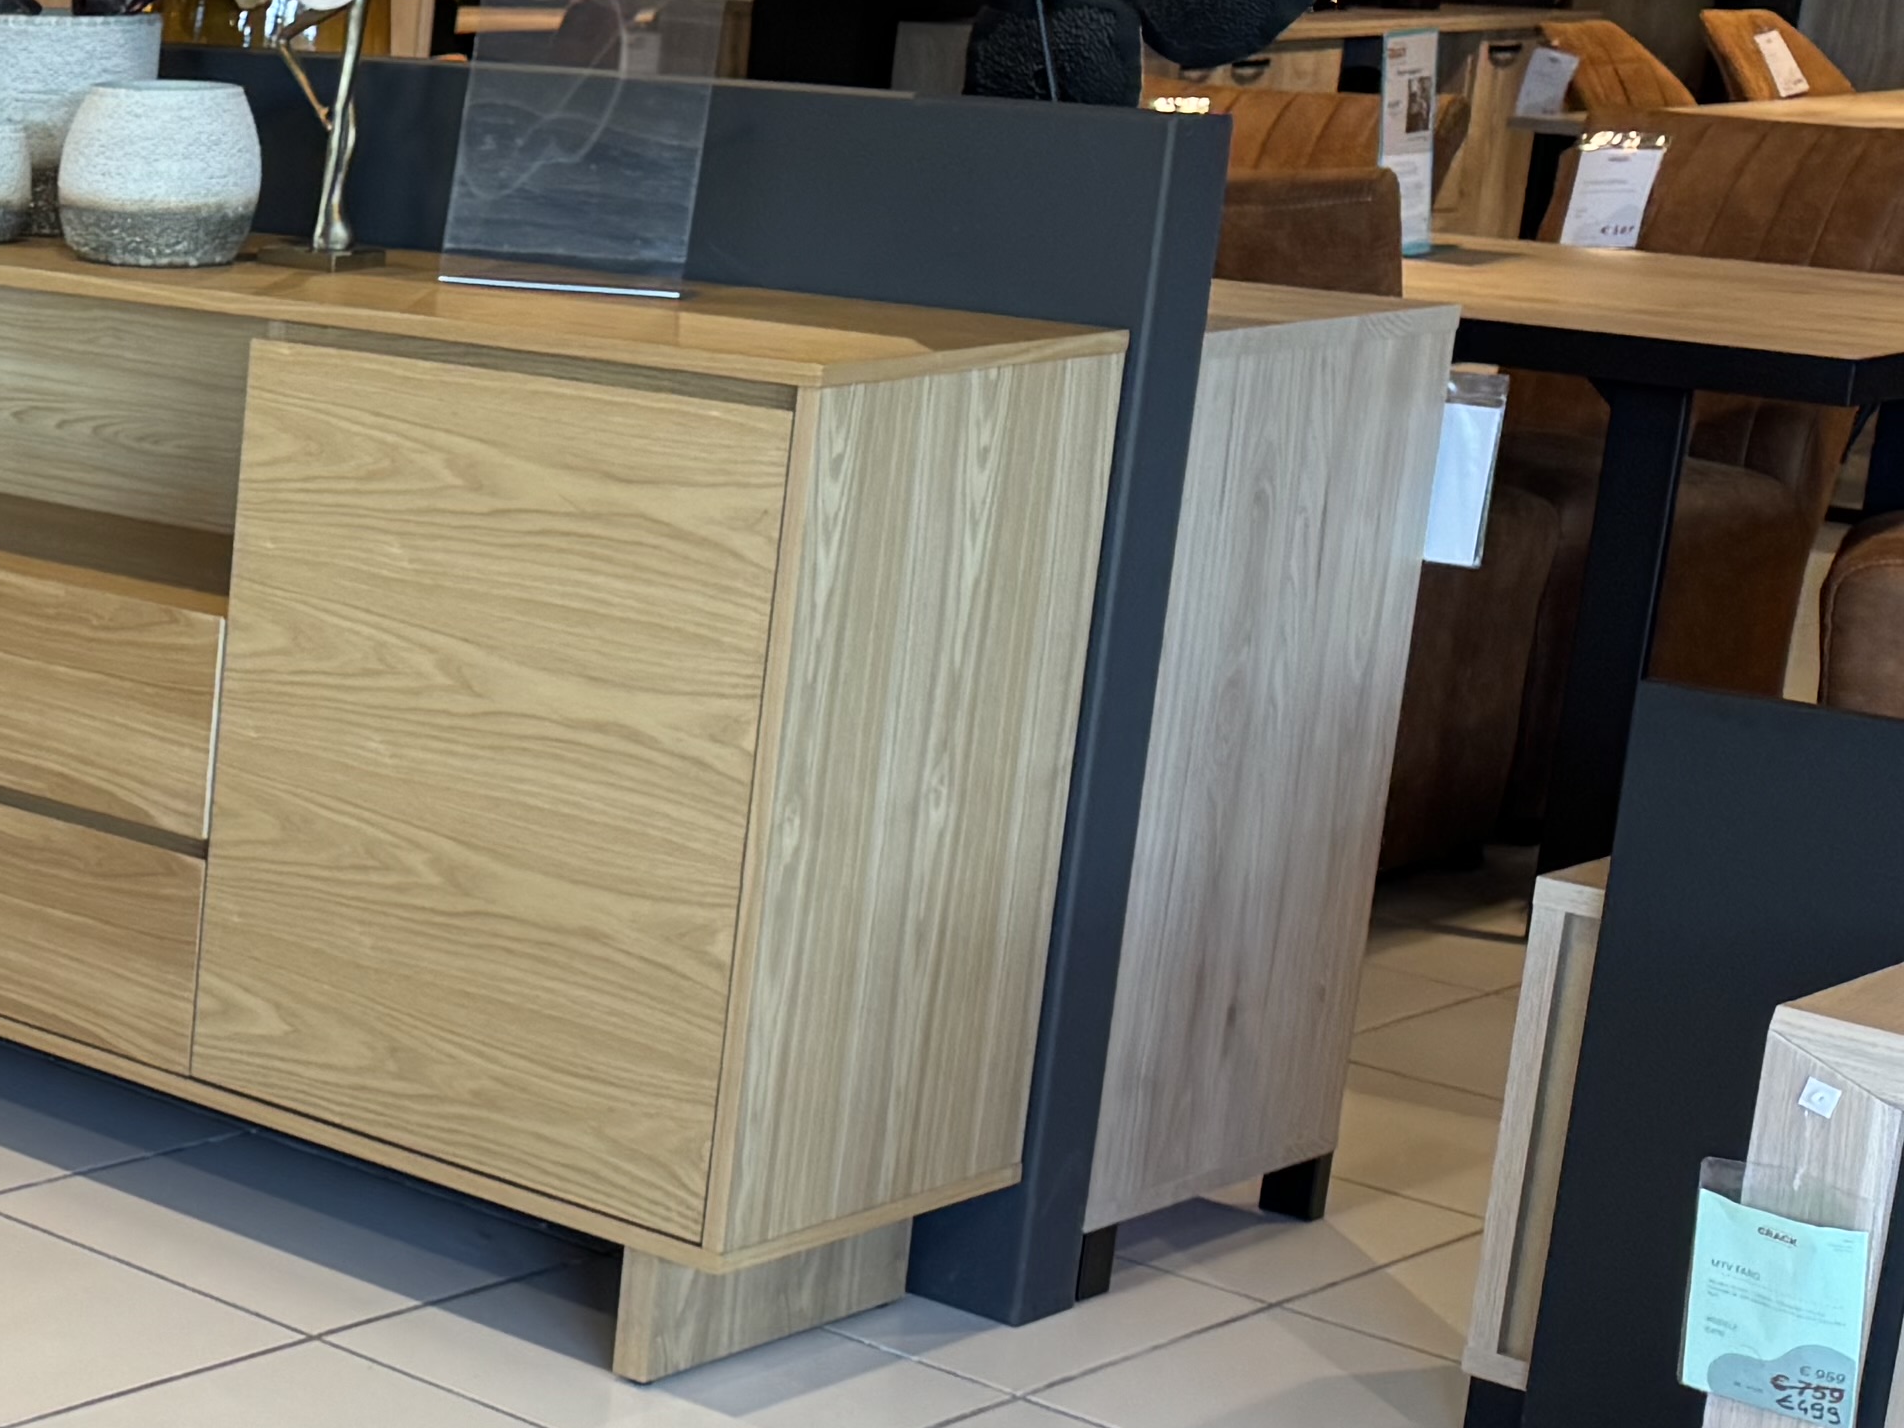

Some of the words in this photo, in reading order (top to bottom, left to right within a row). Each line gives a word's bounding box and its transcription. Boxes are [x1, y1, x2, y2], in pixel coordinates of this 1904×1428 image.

[1757, 1226, 1798, 1247] CRACK
[1799, 1365, 1812, 1377] €
[1815, 1369, 1846, 1384] 959
